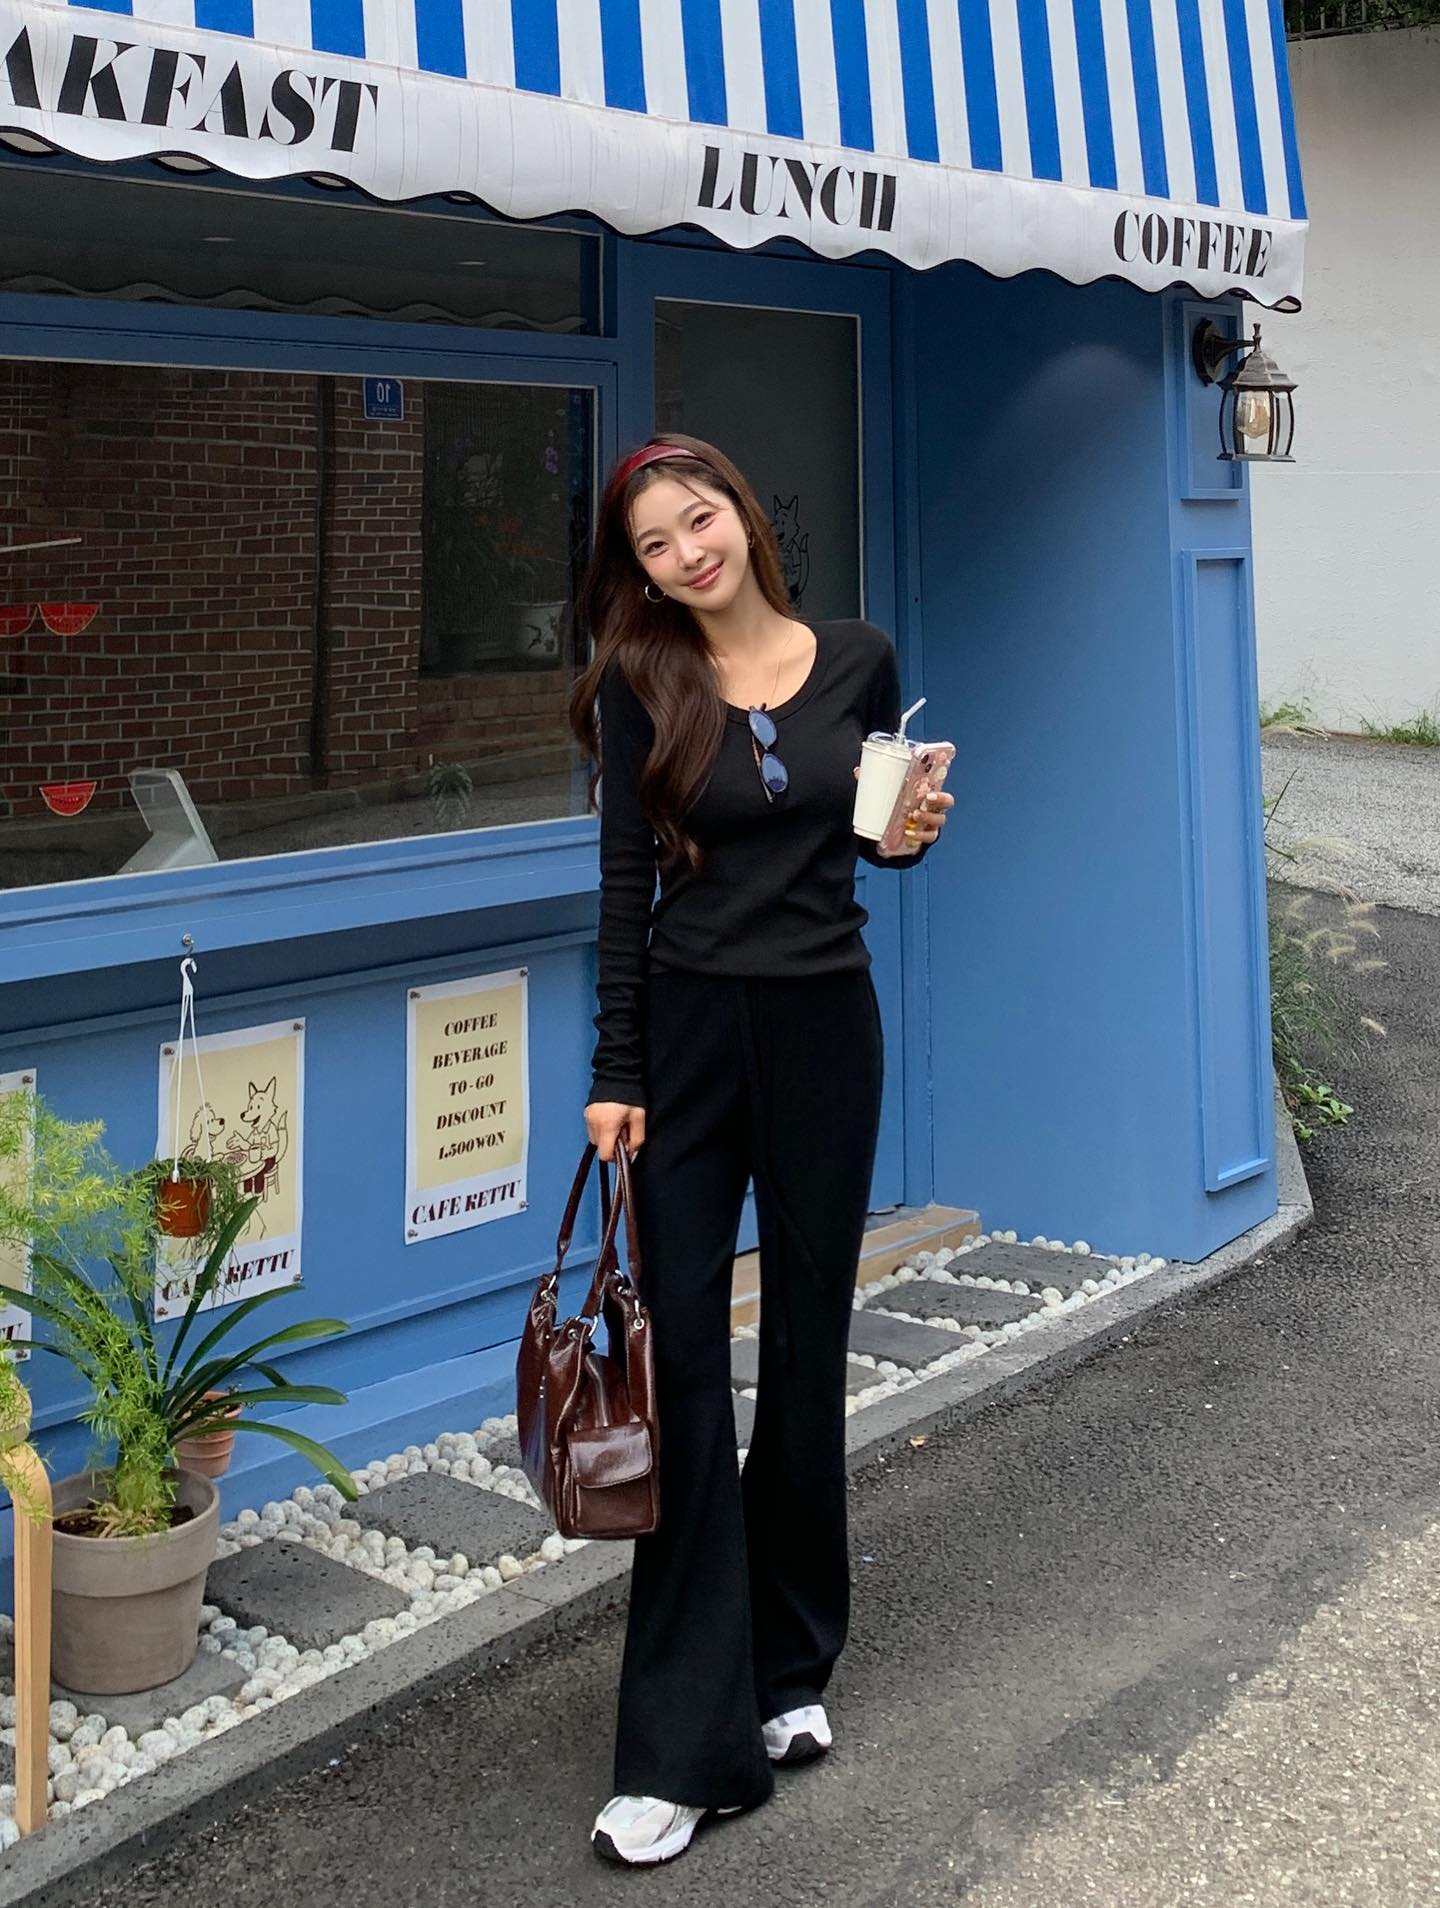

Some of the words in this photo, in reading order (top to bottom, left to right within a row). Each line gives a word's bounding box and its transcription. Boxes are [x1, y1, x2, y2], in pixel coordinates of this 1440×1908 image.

[0, 25, 379, 154] AKFAST
[697, 145, 898, 232] LUNCH
[1114, 209, 1273, 278] COFFEE
[444, 1013, 498, 1037] COFFEE
[432, 1040, 508, 1070] BEVERAGE
[436, 1100, 507, 1130] DISCOUNT
[412, 1196, 462, 1225] CAFE
[465, 1179, 522, 1212] KETTU
[225, 1249, 296, 1285] KETTU
